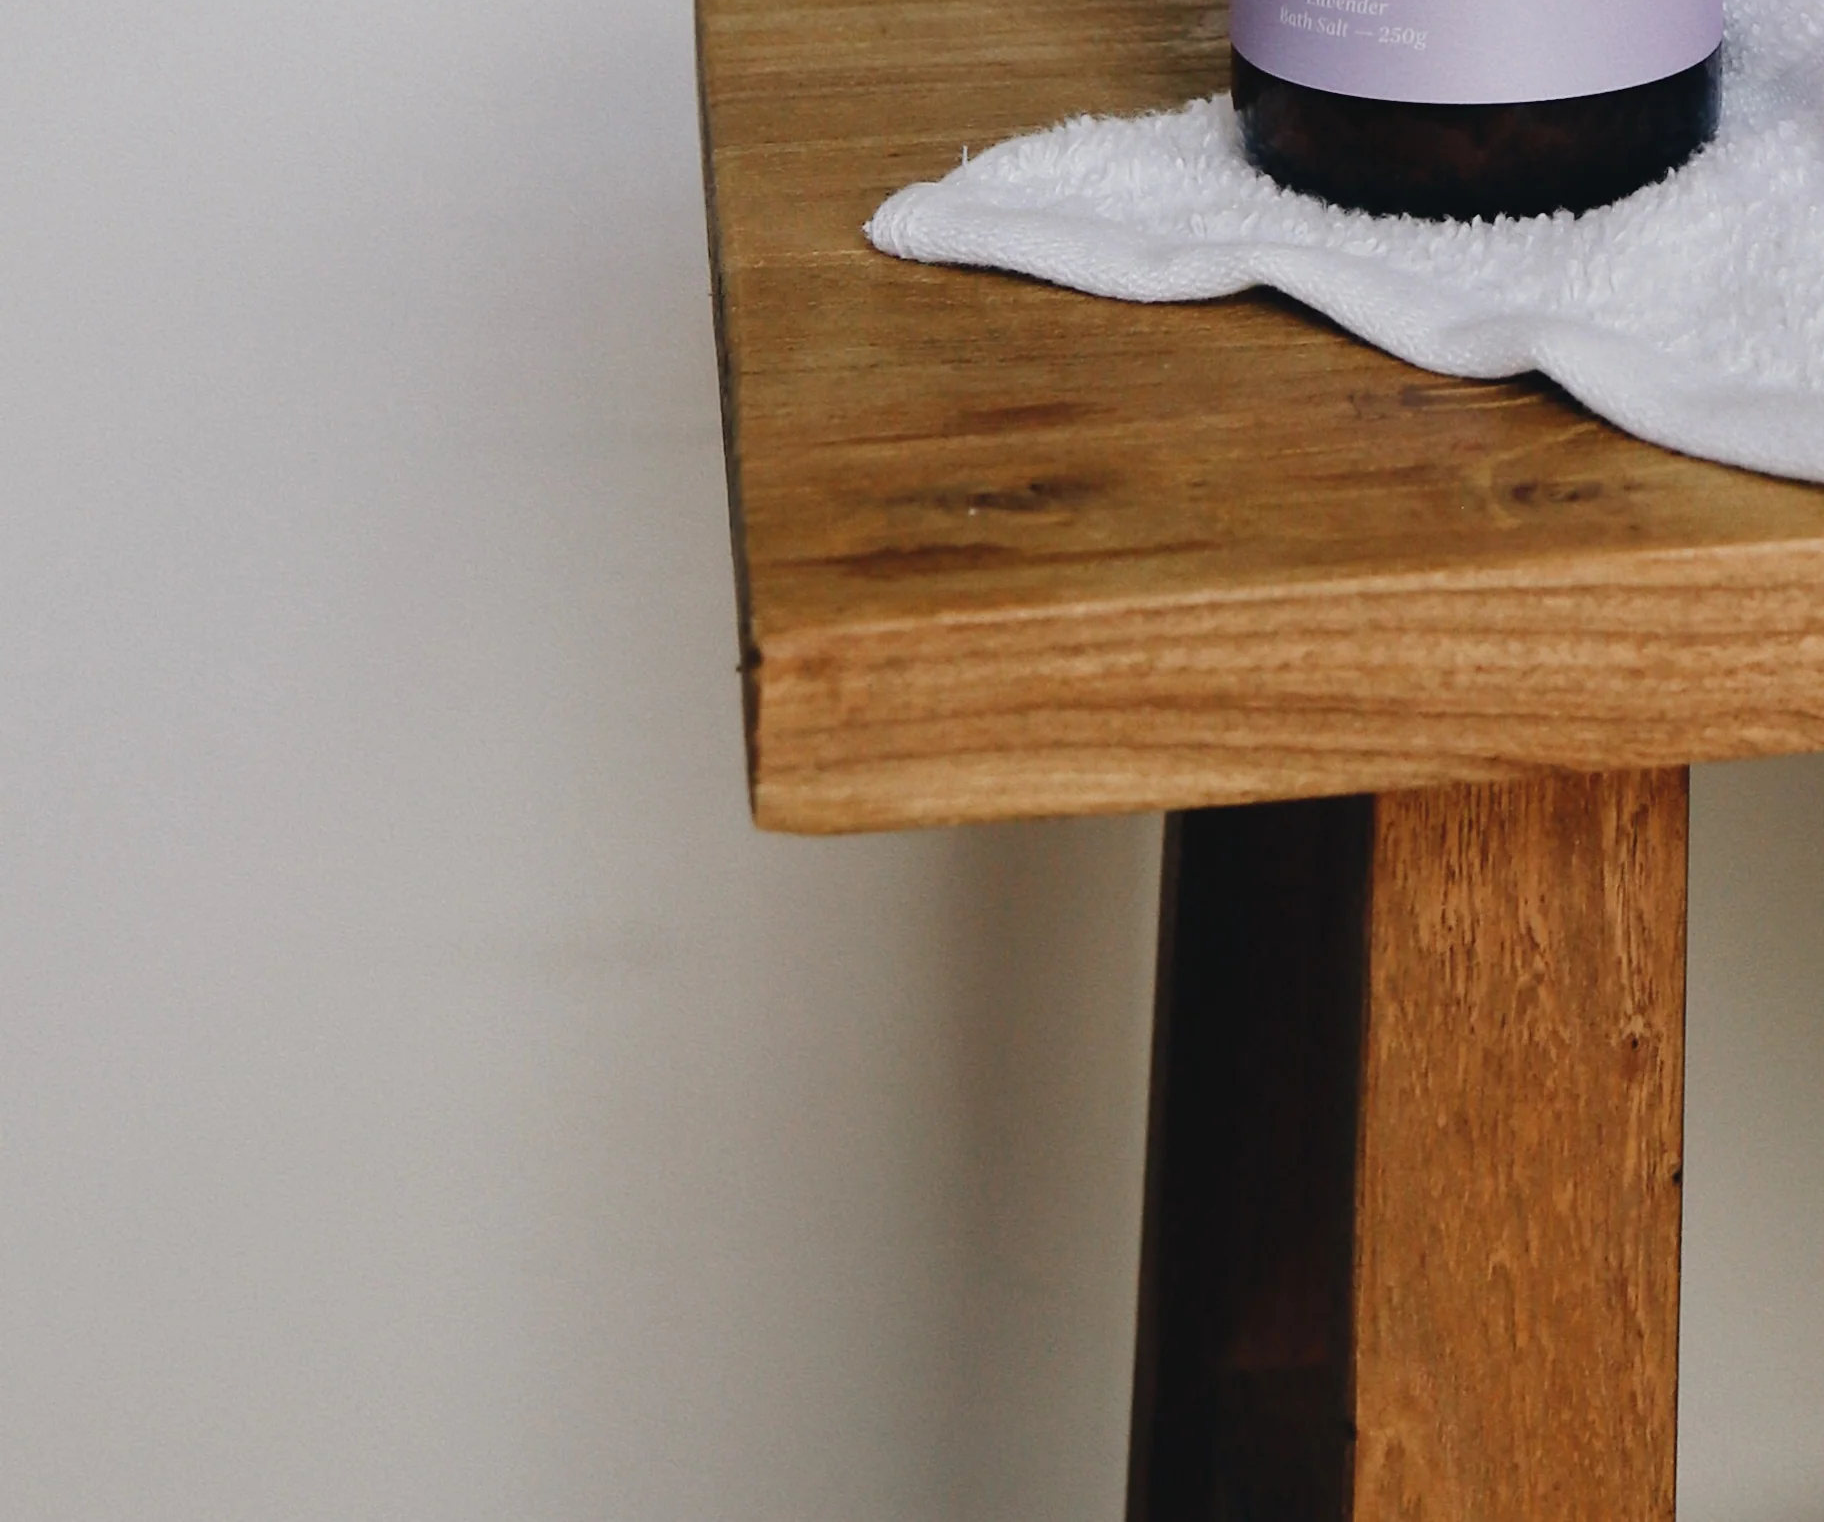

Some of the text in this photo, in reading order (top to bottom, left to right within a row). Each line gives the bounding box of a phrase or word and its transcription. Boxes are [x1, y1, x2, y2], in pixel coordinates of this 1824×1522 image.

[1280, 6, 1312, 30] Bath
[1317, 14, 1348, 37] Salt
[1379, 25, 1429, 51] 250g
